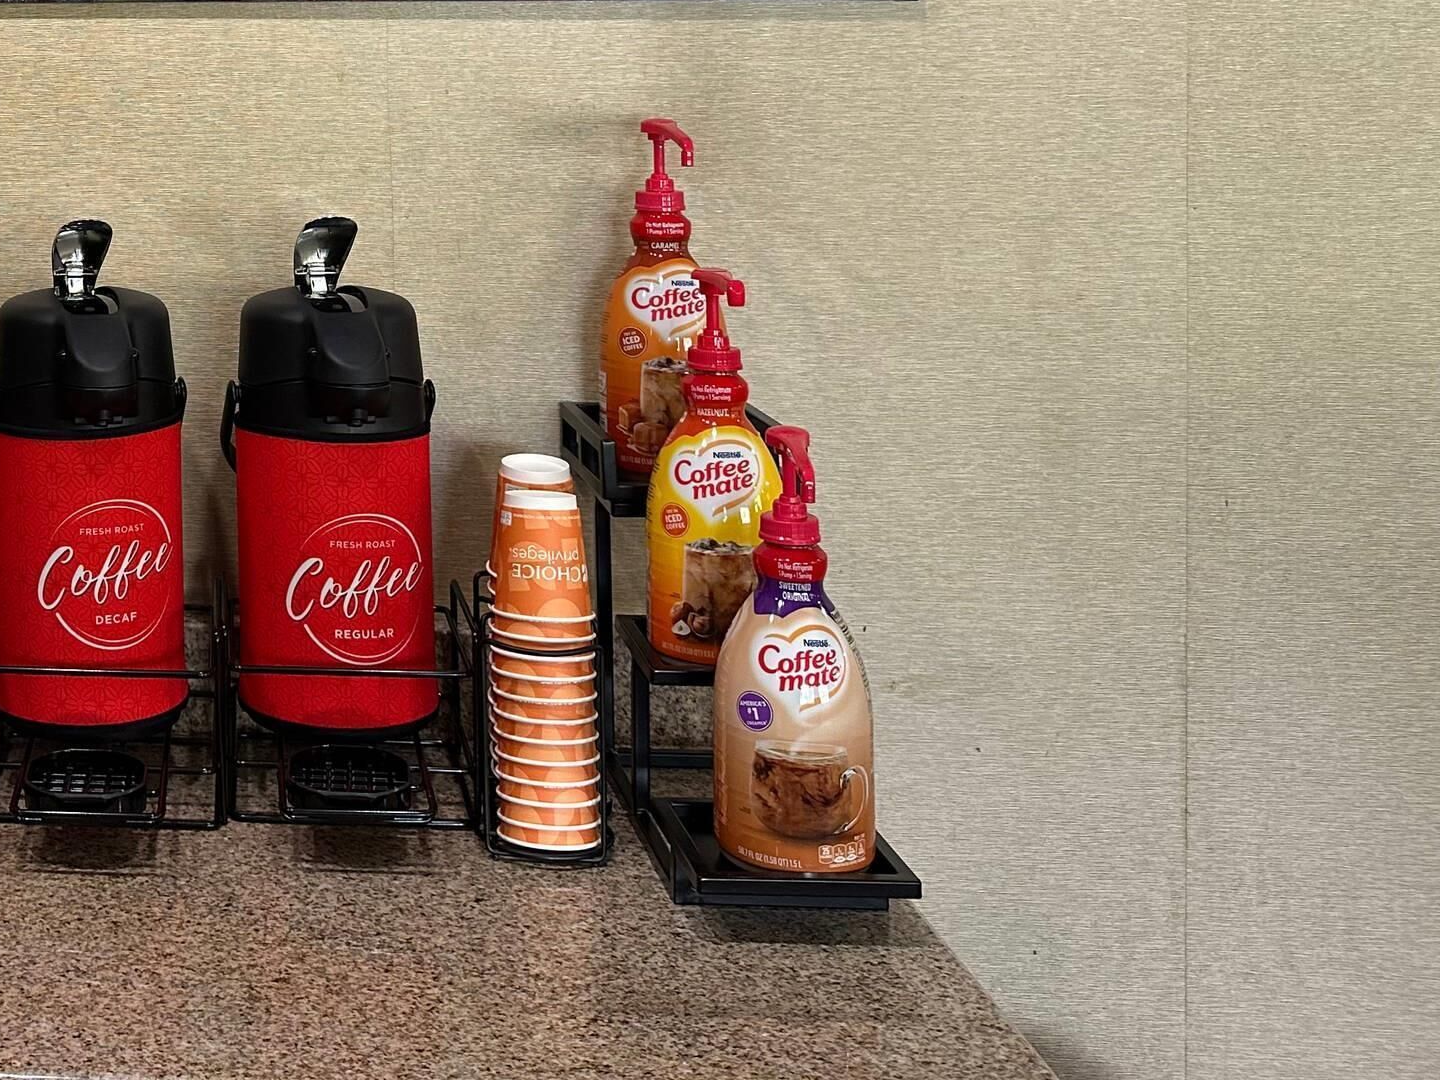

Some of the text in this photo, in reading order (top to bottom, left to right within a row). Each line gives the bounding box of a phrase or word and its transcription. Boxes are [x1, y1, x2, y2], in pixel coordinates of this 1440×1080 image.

[631, 286, 701, 310] Coffee
[651, 300, 705, 322] mate
[622, 336, 641, 345] ICED
[623, 344, 643, 352] COFFEE
[696, 408, 729, 417] HAZELNUT
[674, 460, 751, 485] Coffee
[692, 473, 753, 500] mate
[665, 513, 683, 523] ICED
[79, 523, 145, 536] FRESH ROAST
[666, 522, 686, 530] COFFEE
[329, 539, 396, 549] FRESH ROAST
[37, 539, 174, 610] Coffee
[511, 563, 581, 583] CHOICE
[285, 555, 425, 621] Coffee
[778, 581, 812, 591] SWEETENED
[95, 611, 138, 625] DECAF
[334, 628, 394, 640] REGULAR
[758, 644, 837, 674] Coffee
[779, 665, 840, 692] mate
